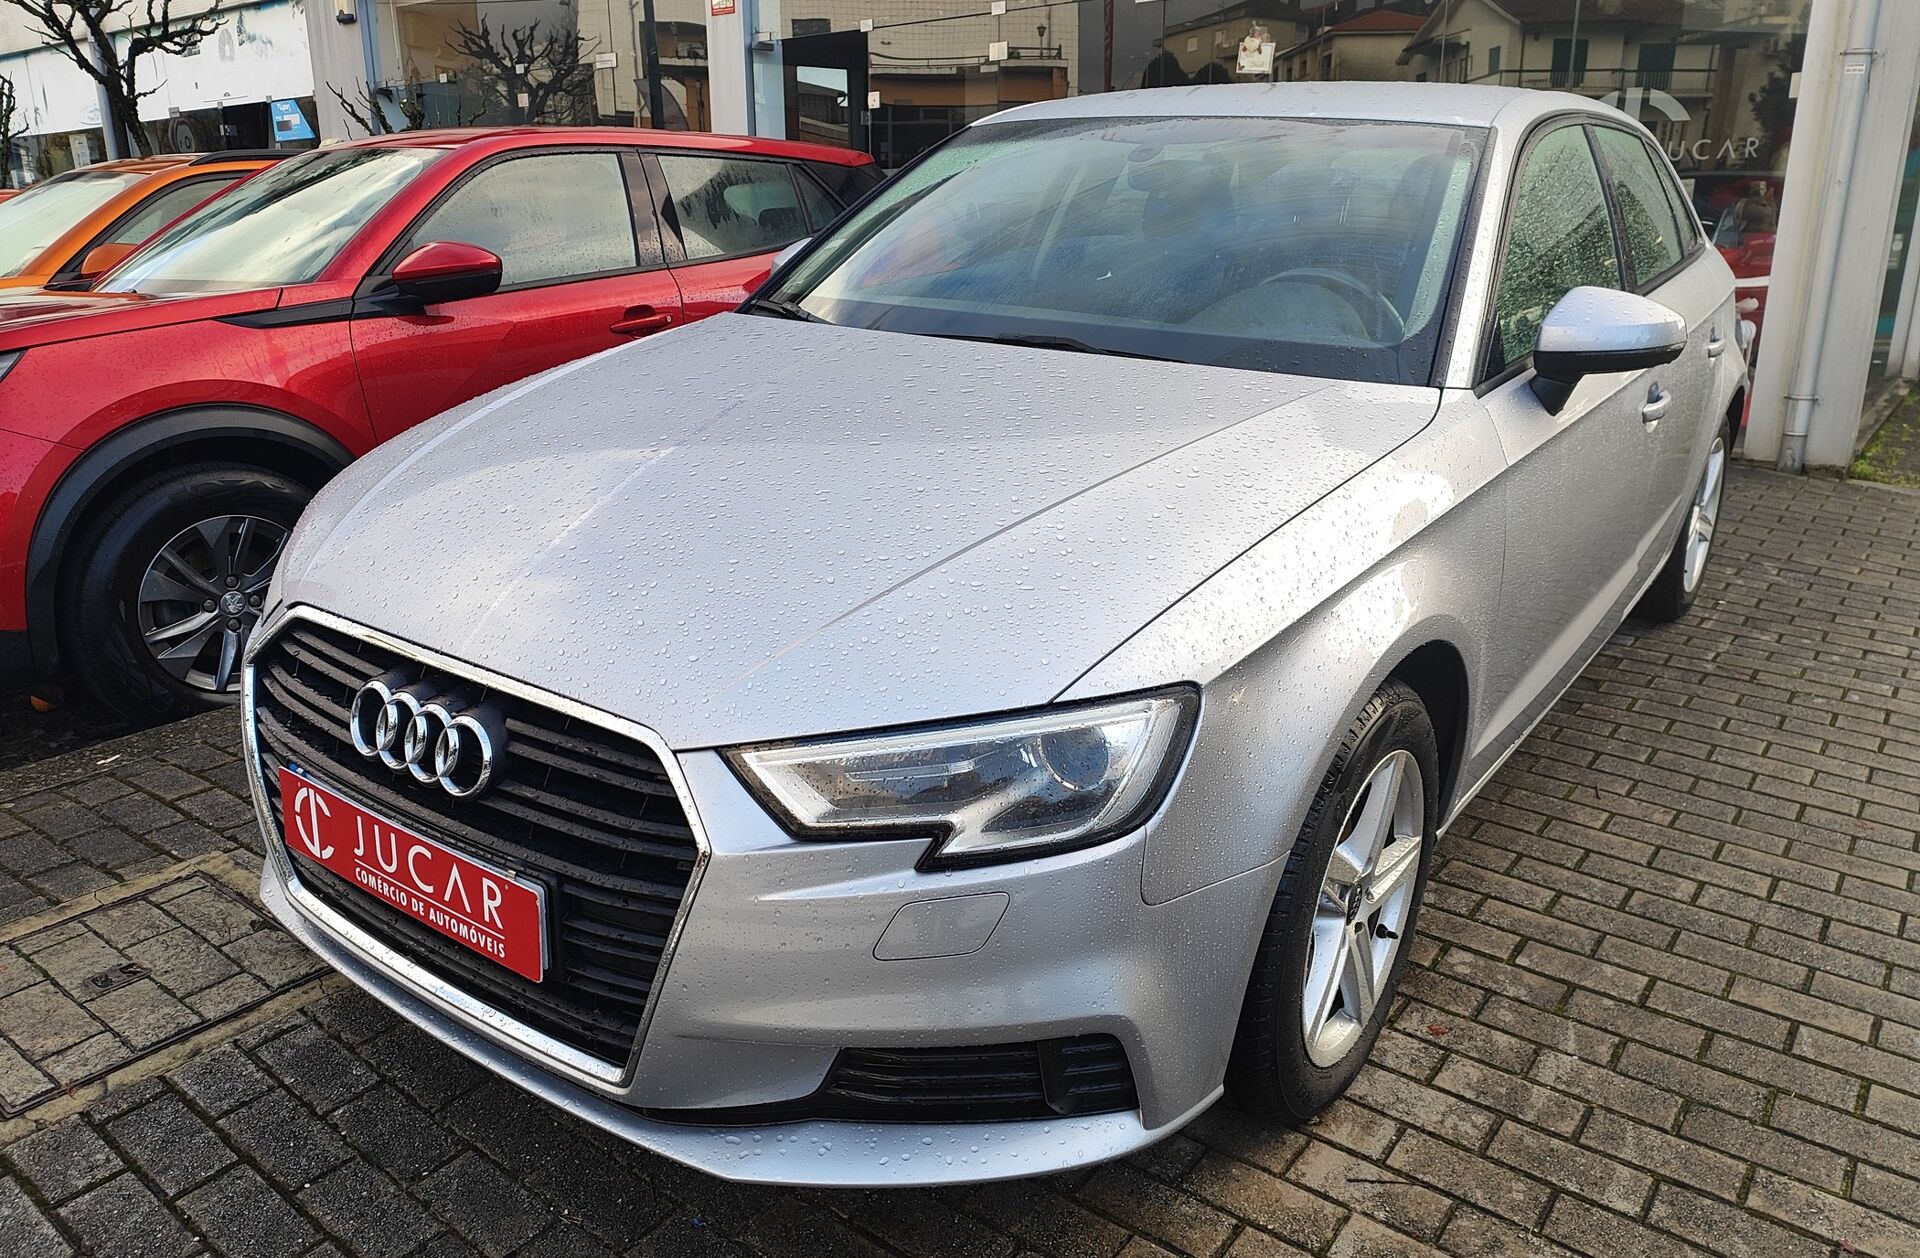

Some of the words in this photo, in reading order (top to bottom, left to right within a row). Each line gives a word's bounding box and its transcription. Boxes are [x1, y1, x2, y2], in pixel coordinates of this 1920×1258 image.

[1667, 137, 1760, 161] UCAR
[354, 815, 503, 930] JUCAR
[355, 867, 407, 907] COMÉRCIO
[411, 900, 425, 916] DE
[429, 907, 506, 959] AUTOMÓVEIS
